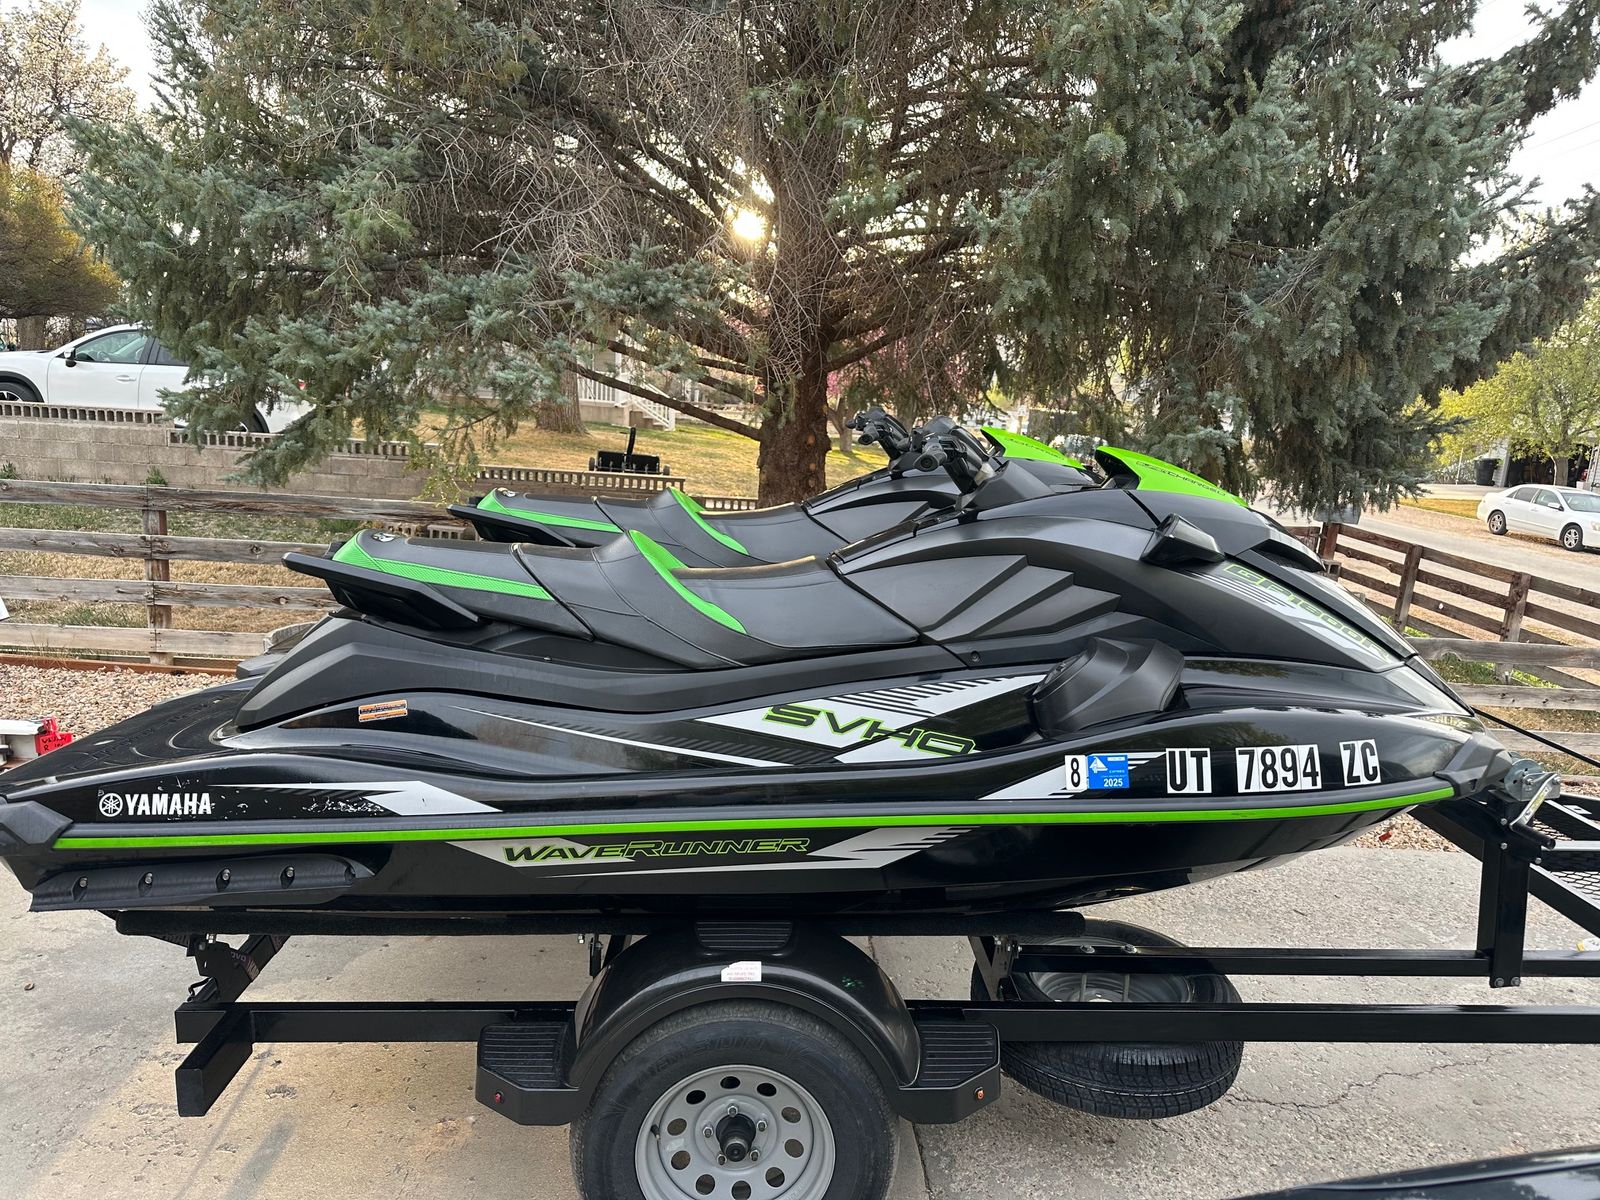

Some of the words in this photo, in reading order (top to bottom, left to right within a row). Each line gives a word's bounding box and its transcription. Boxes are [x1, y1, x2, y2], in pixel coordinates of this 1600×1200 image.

[762, 704, 976, 757] SVHO
[1070, 757, 1081, 788] 8
[1168, 750, 1208, 792] UT
[1238, 747, 1319, 790] 7894
[1342, 741, 1379, 784] ZC
[1103, 778, 1124, 787] 2025
[124, 793, 212, 816] YAMAHA
